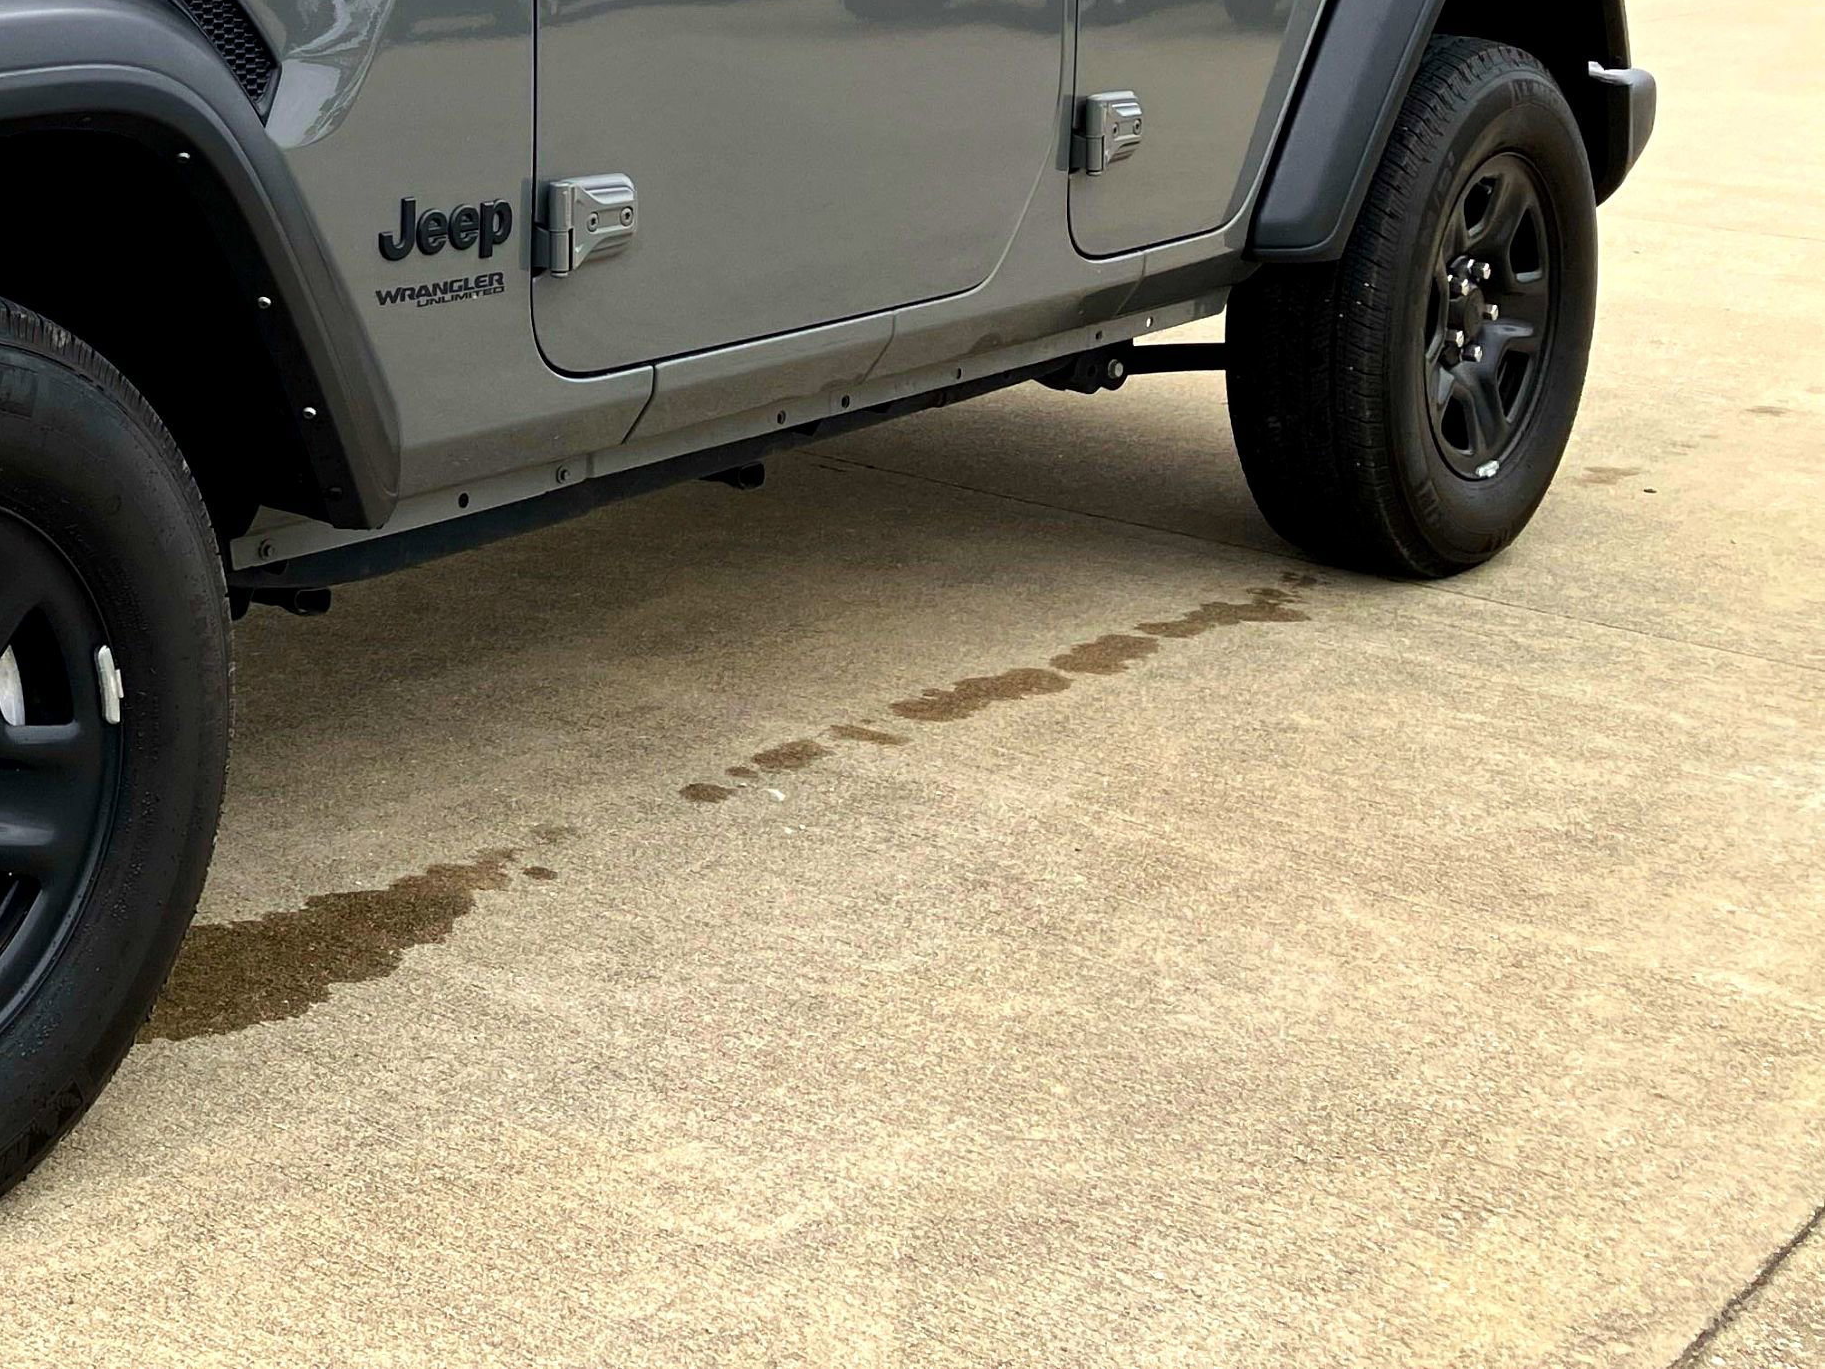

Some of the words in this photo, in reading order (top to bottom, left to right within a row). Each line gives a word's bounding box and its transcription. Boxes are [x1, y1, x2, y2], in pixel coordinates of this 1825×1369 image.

[378, 196, 513, 262] Jeep
[375, 272, 505, 306] WRANGLER
[417, 286, 505, 308] UNLIMITED
